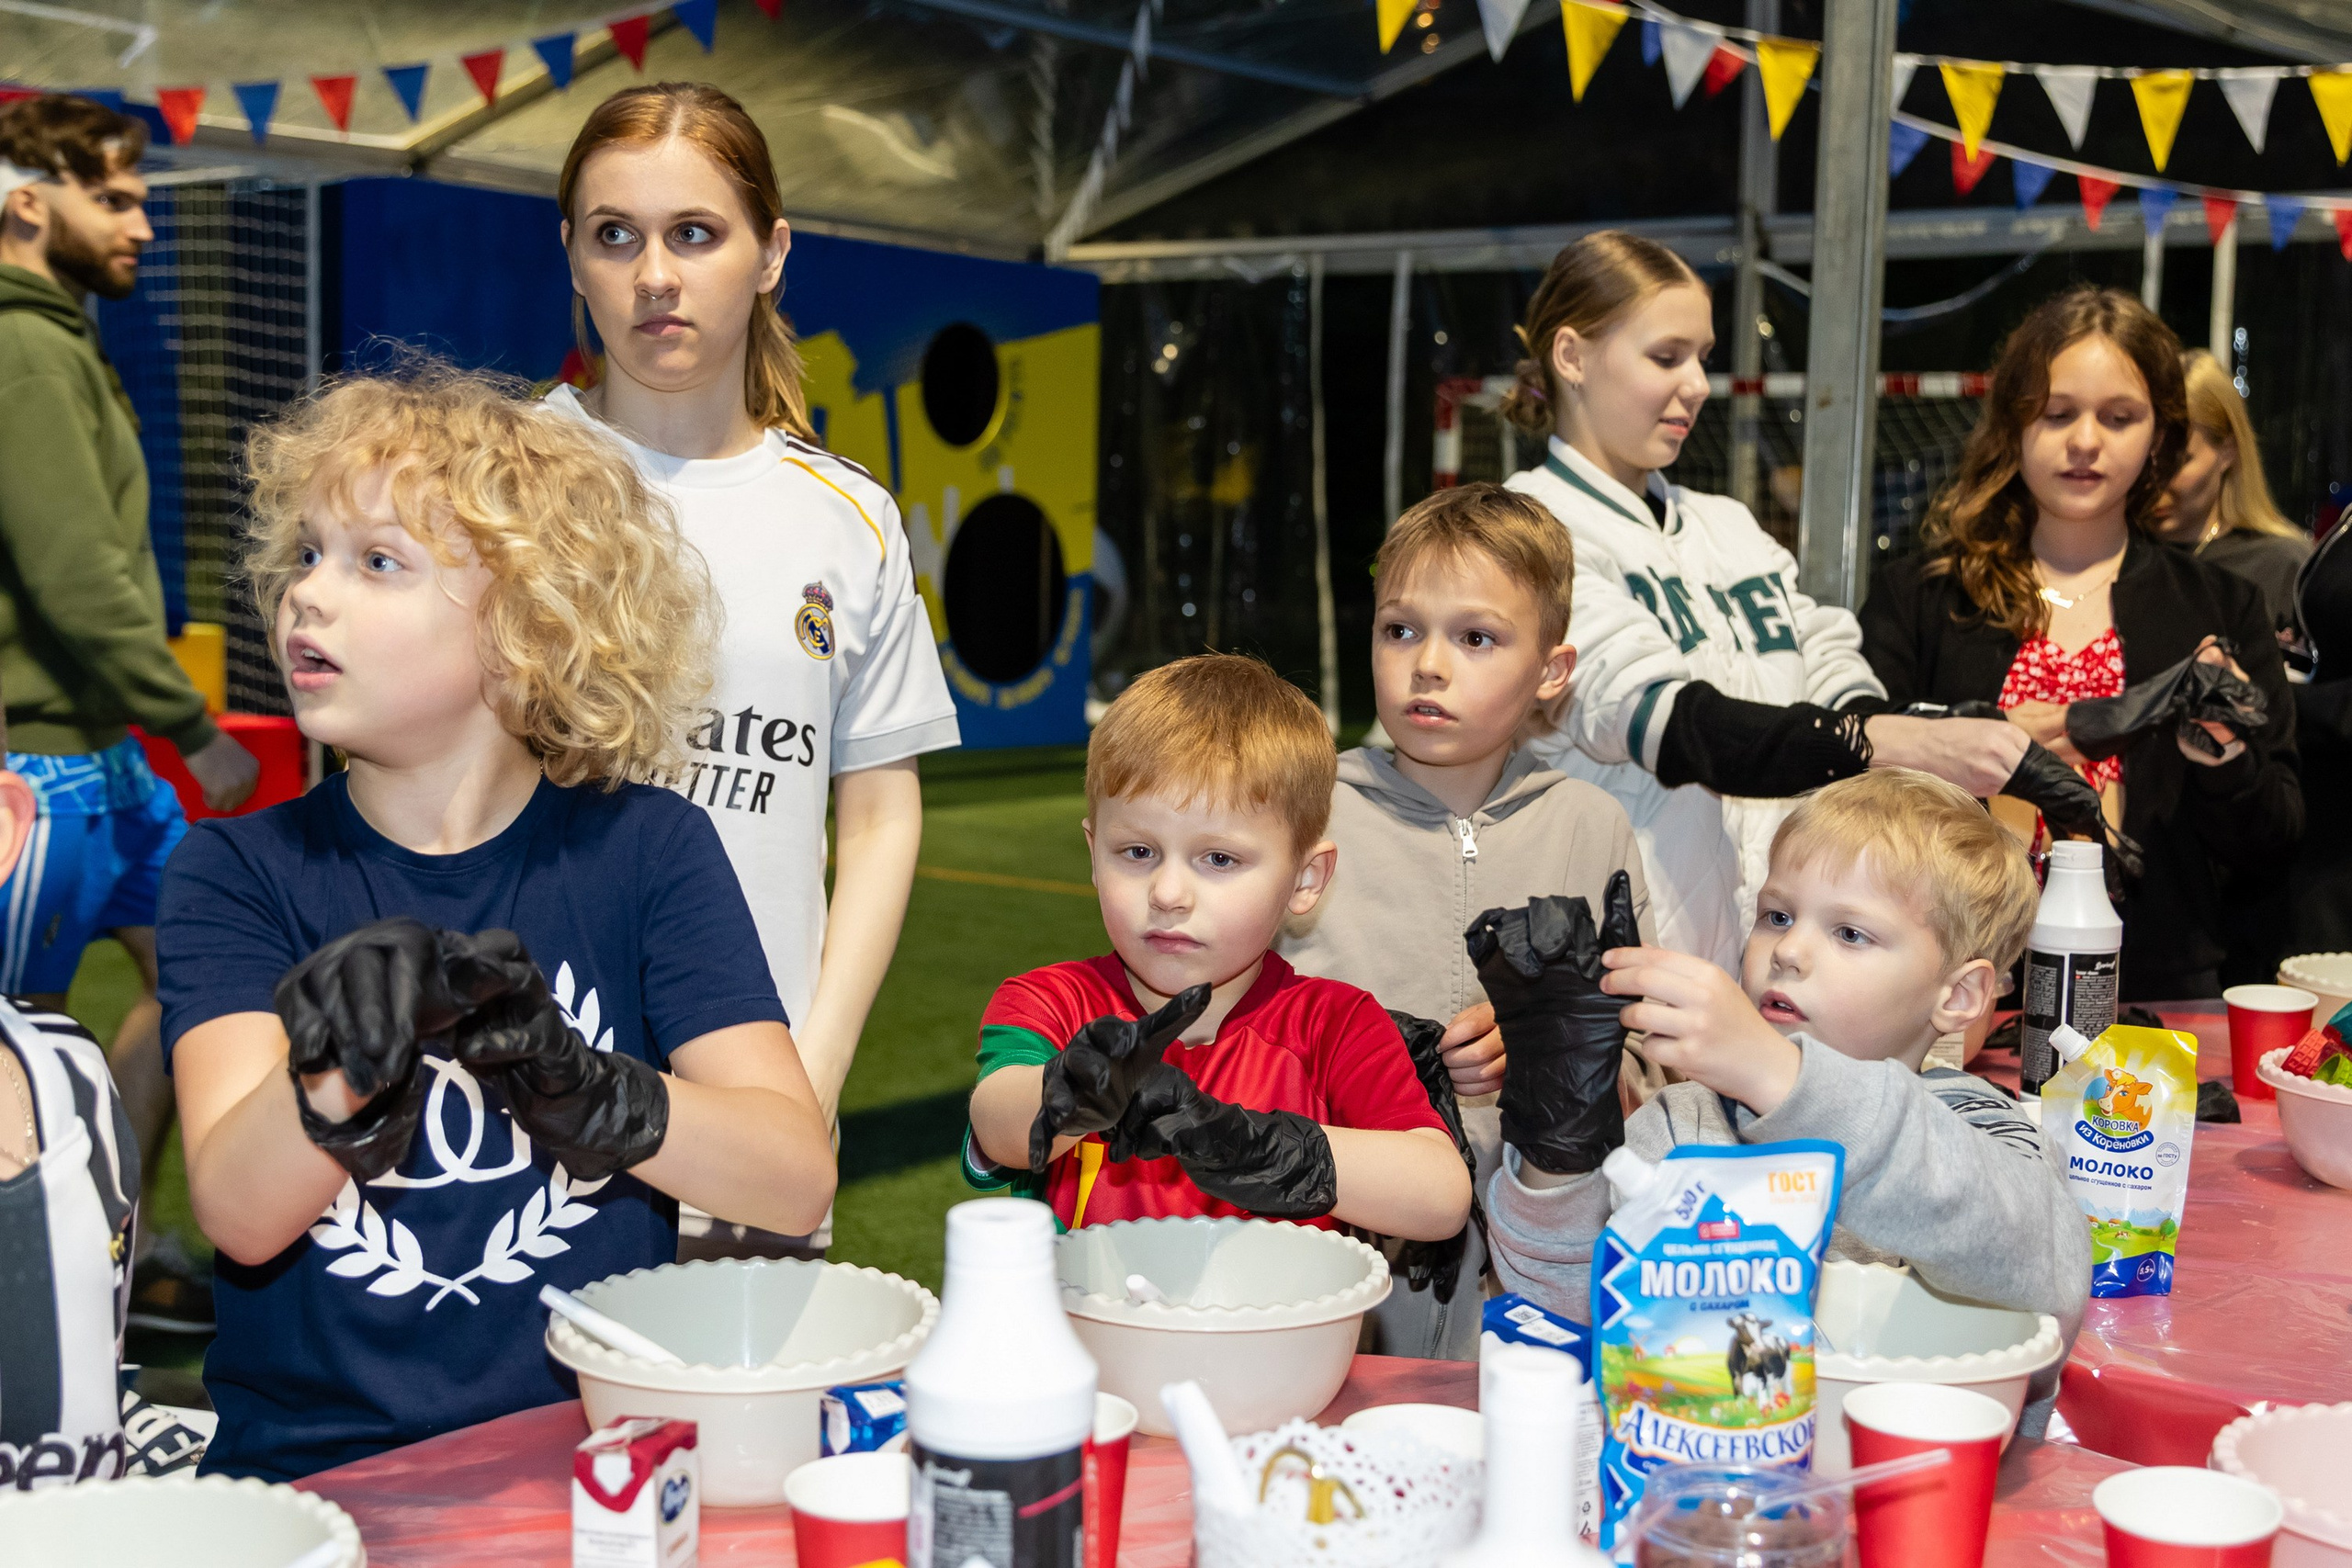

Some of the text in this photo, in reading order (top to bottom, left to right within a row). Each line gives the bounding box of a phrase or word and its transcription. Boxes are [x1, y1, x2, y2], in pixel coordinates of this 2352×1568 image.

[685, 705, 816, 767] ates
[2092, 1115, 2140, 1132] КОРОВКА
[2091, 1133, 2150, 1151] Кореновки
[1768, 1171, 1816, 1193] ГОСТ
[1640, 1256, 1803, 1298] МОЛОКО
